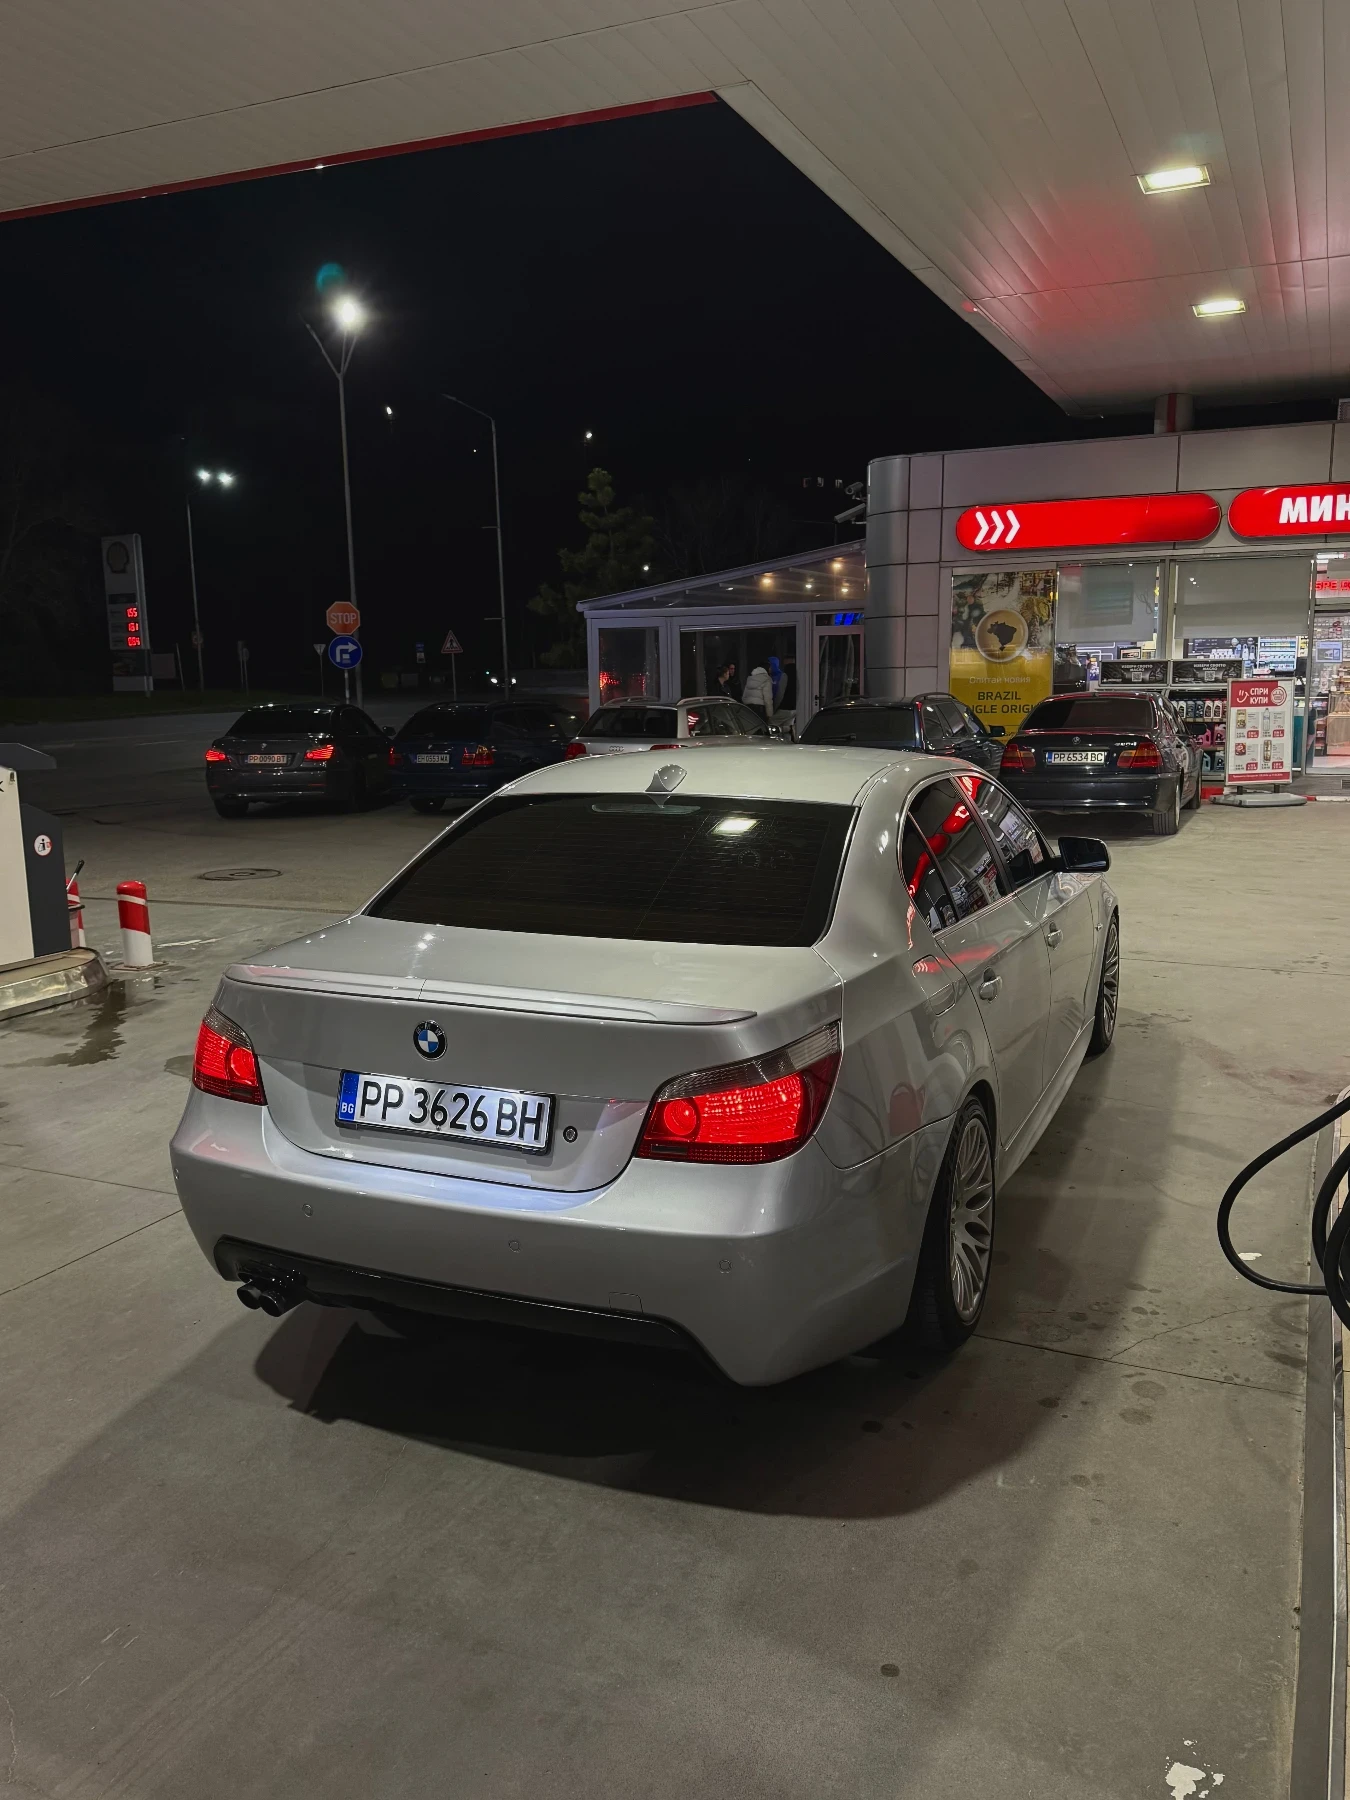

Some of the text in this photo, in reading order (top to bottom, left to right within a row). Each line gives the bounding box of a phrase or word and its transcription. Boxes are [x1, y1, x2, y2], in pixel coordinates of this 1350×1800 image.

[330, 612, 357, 625] STOP
[977, 691, 1021, 701] BRAZIL
[1250, 687, 1269, 696] СПРИ
[1249, 696, 1269, 705] КУПИ
[248, 755, 286, 763] PP 0090 BT
[417, 755, 425, 763] EH
[1053, 752, 1103, 762] PP 6534 BC
[341, 1101, 354, 1114] BG
[359, 1080, 545, 1141] PP 3626 BH
